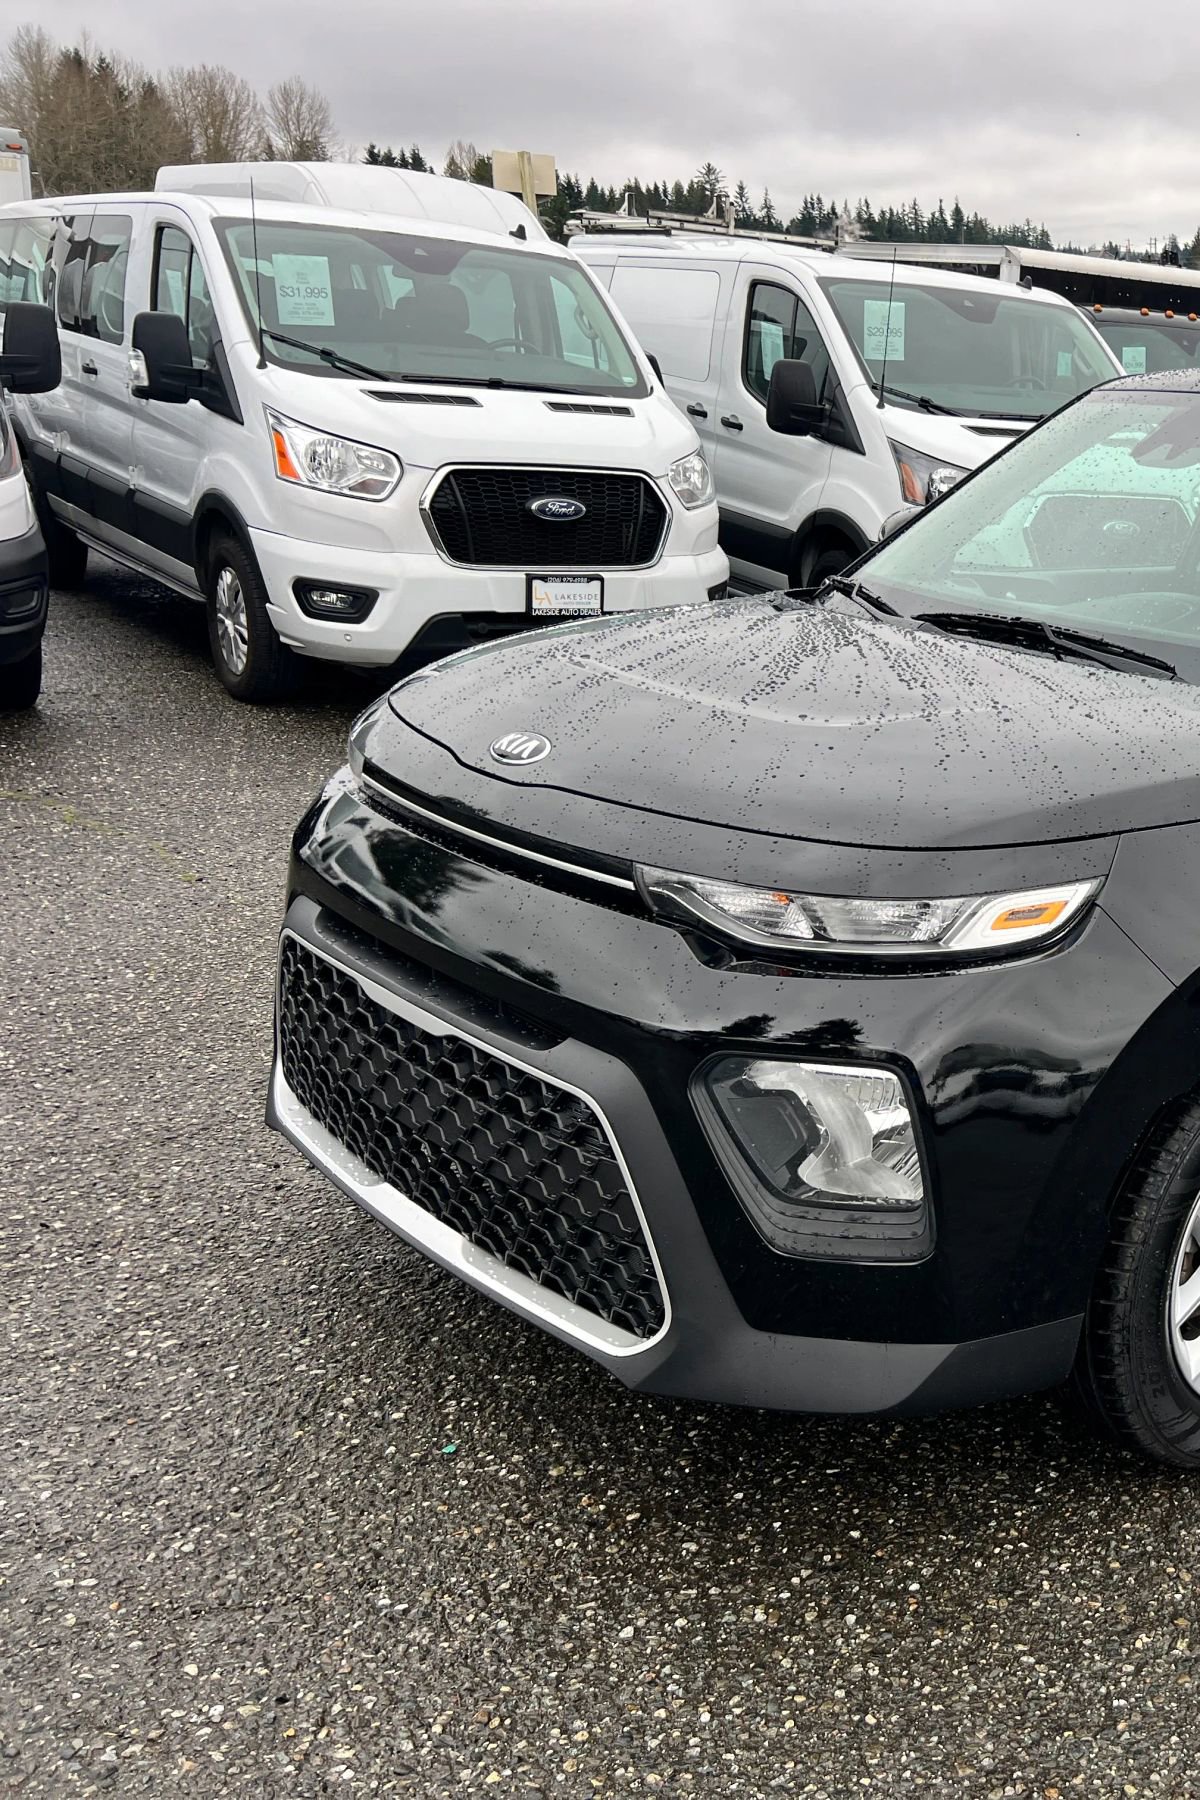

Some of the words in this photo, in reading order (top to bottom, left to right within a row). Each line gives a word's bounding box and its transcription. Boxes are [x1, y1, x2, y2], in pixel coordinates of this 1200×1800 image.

[279, 285, 329, 299] $31,995
[545, 501, 576, 515] Ford
[554, 593, 599, 601] LAKESIDE
[532, 608, 560, 616] LAKESIDE
[561, 608, 579, 616] AUTO
[580, 608, 602, 616] DEALER
[493, 733, 541, 759] KIA
